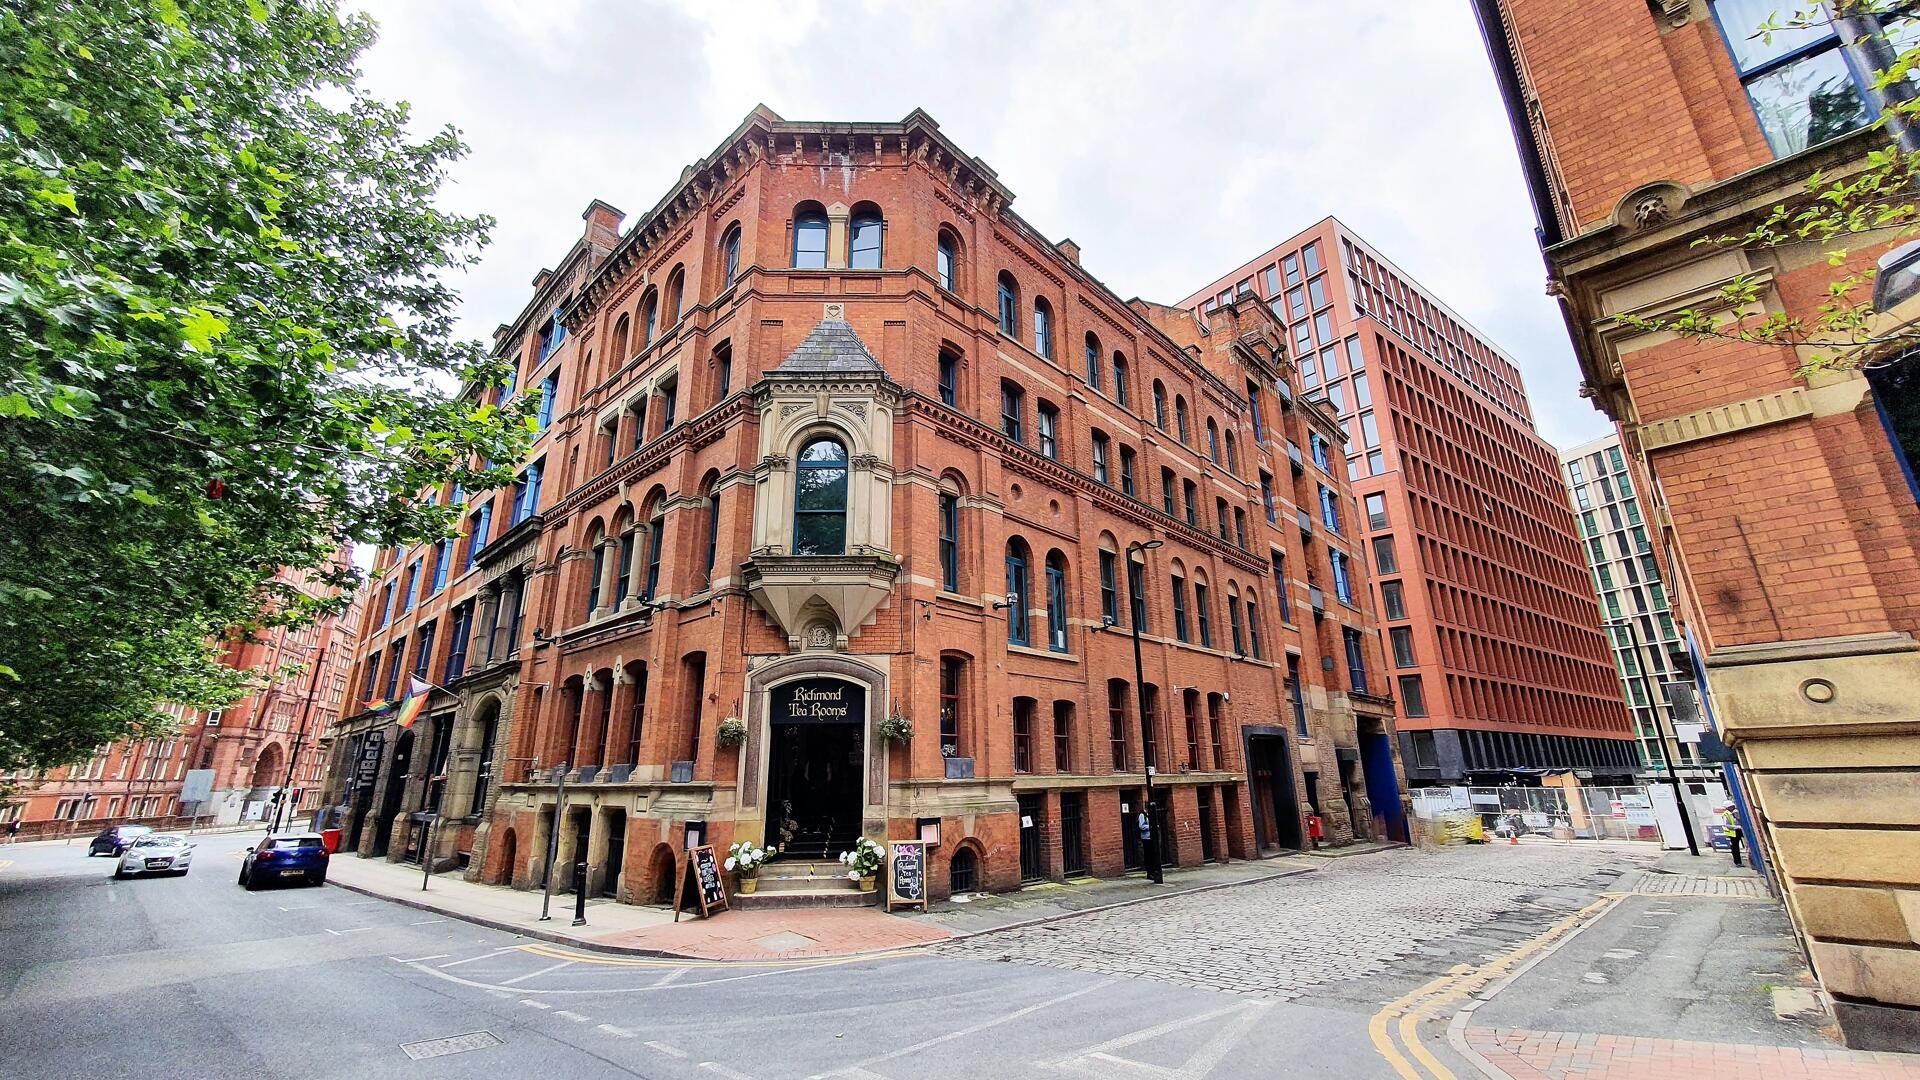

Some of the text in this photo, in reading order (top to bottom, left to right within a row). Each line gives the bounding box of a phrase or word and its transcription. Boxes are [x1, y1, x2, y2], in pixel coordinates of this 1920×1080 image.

[793, 686, 845, 706] Richmond
[788, 702, 849, 721] Tea Rooms
[355, 732, 383, 789] TriBeCa
